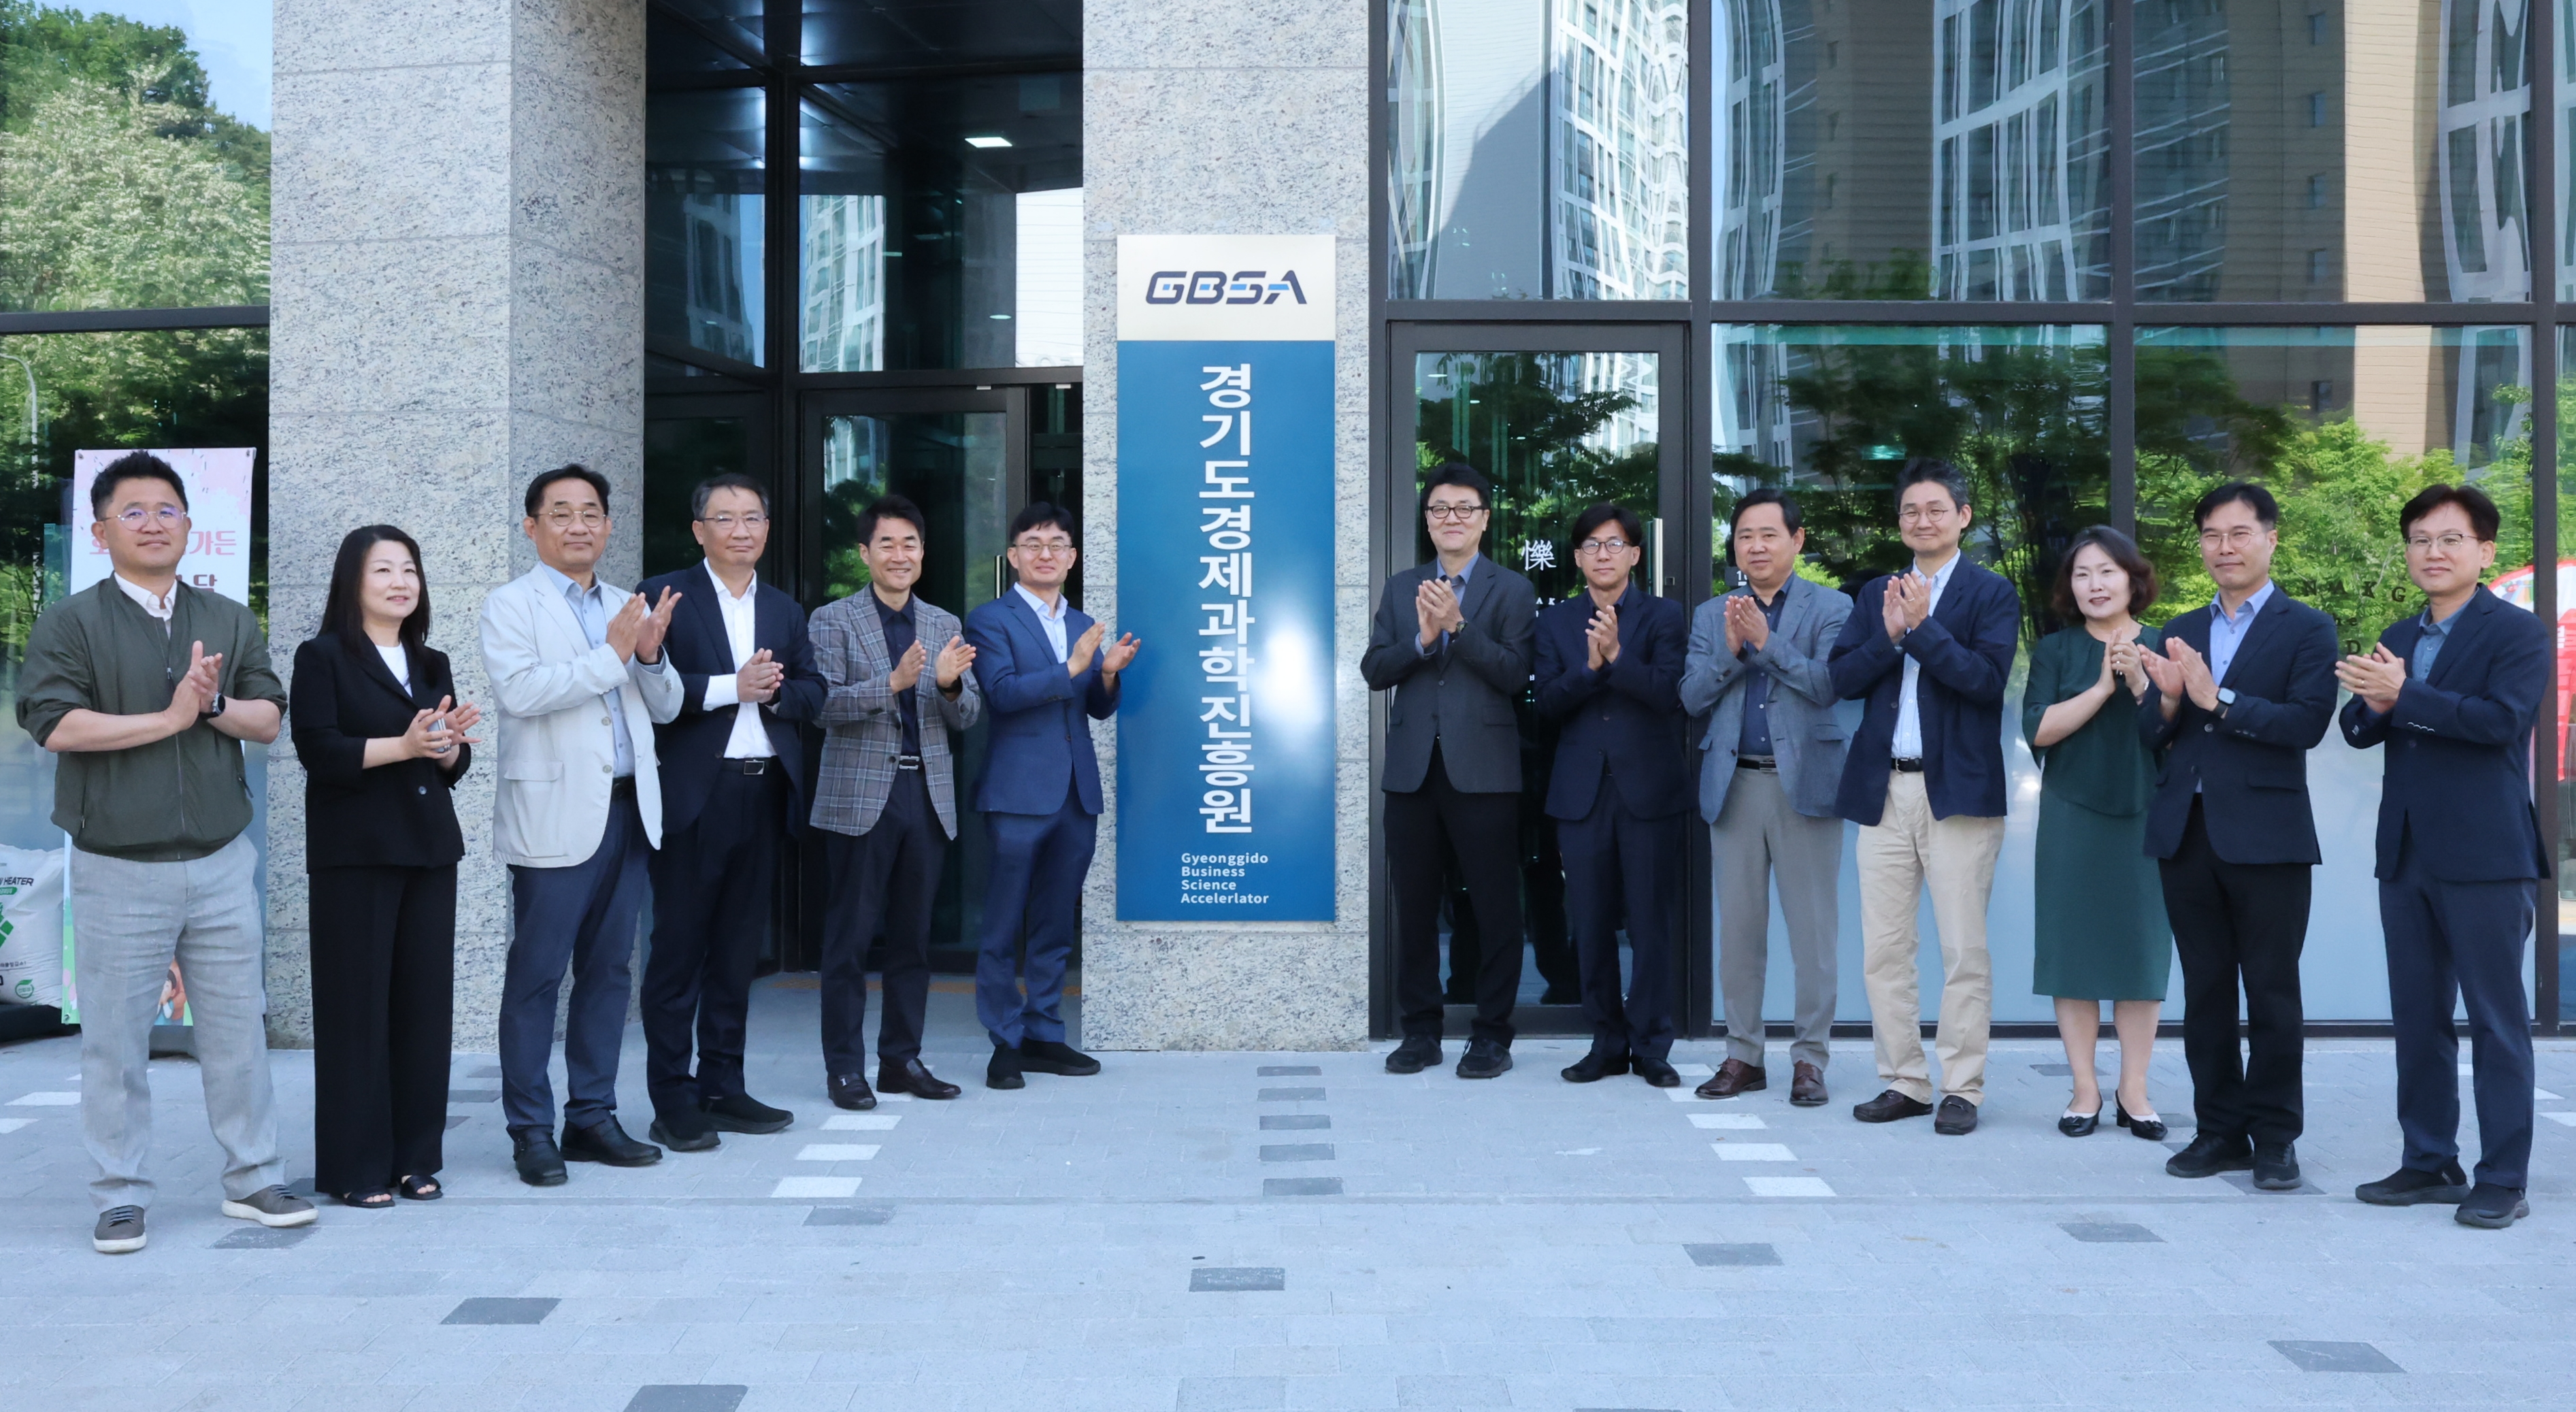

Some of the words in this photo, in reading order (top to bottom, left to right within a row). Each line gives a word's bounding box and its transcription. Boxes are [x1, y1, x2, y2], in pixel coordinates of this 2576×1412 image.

[1146, 270, 1307, 304] GBSA
[1199, 363, 1255, 833] 경기도경제과학진흥원
[1181, 853, 1268, 866] Gyeonggido
[1181, 866, 1245, 876] Business
[3, 877, 34, 887] HEATER
[1181, 879, 1236, 890] Science
[1180, 893, 1269, 904] Accelerlator
